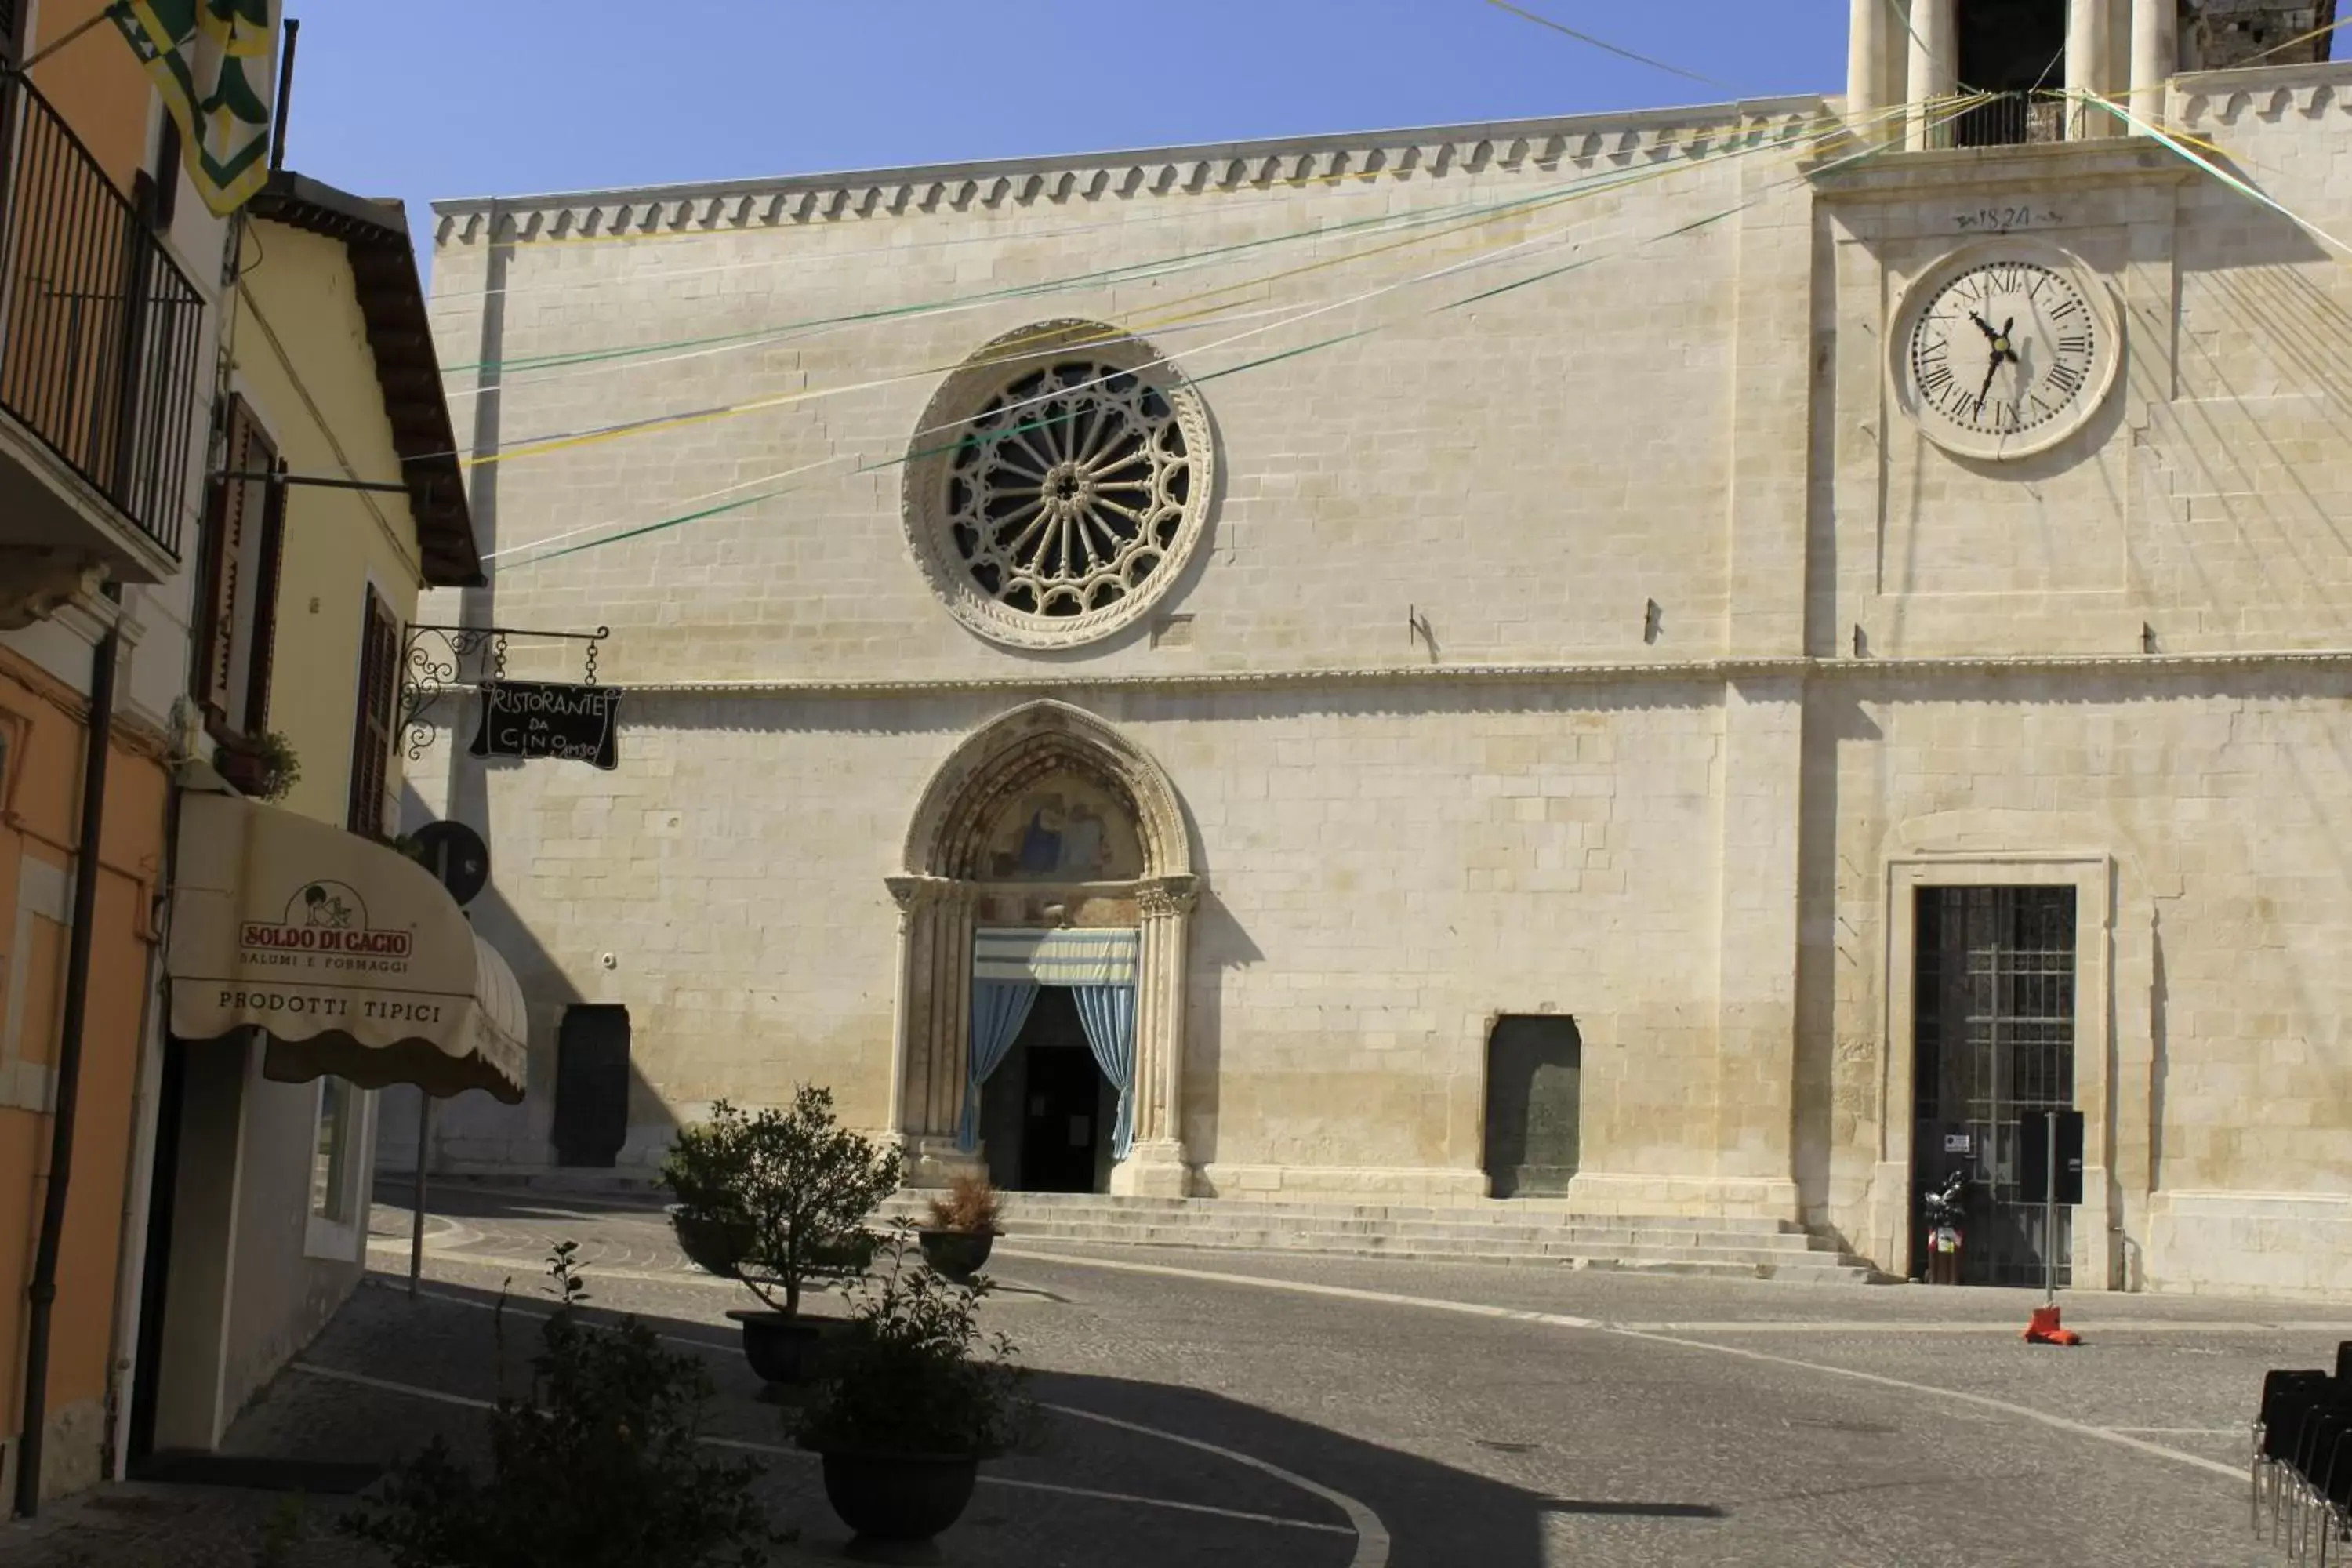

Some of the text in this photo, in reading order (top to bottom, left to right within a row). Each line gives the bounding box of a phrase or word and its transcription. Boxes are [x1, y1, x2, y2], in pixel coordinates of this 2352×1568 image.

[494, 688, 604, 717] RISTORANTE
[529, 717, 549, 731] DA
[500, 728, 568, 750] GINO
[245, 926, 408, 955] SOLDO DI CACIO
[240, 952, 408, 974] SALUMI E FORMAGGI
[220, 991, 441, 1022] PRODOTTI TIPICI
